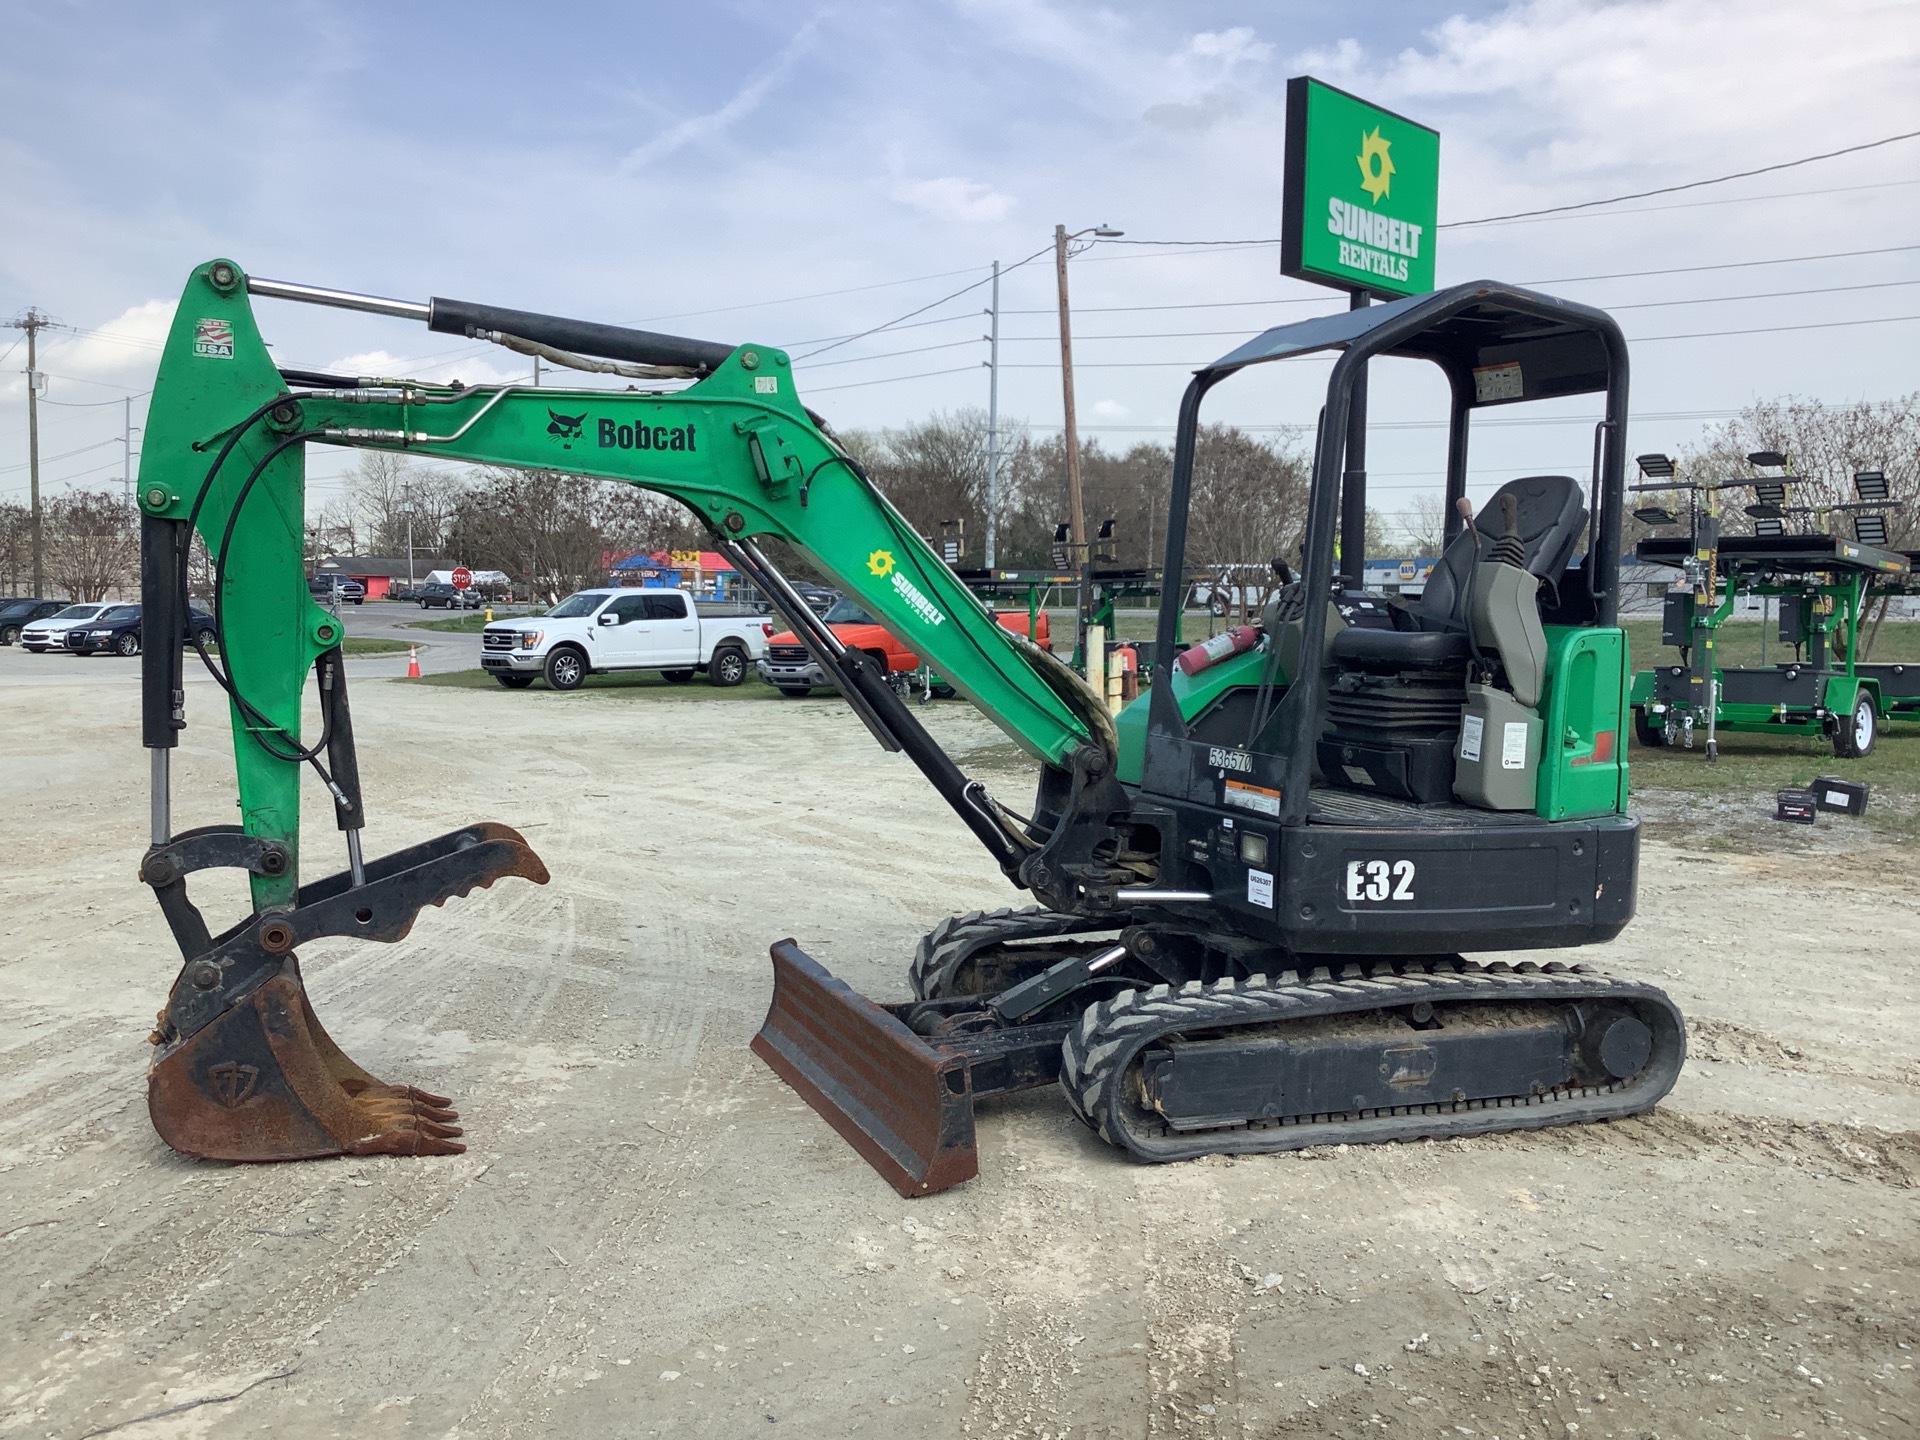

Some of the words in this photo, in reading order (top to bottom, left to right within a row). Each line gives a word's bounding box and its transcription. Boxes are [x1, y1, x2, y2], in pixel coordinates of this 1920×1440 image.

[1328, 197, 1422, 259] SUNBELT
[1339, 241, 1408, 282] RENTALS
[196, 344, 230, 355] USA
[598, 418, 696, 452] Bobcat
[453, 574, 470, 583] STOP
[1708, 547, 1718, 606] NATIONAL
[891, 572, 946, 626] SUNBELT
[1210, 751, 1252, 772] 536570
[1346, 860, 1415, 901] E32
